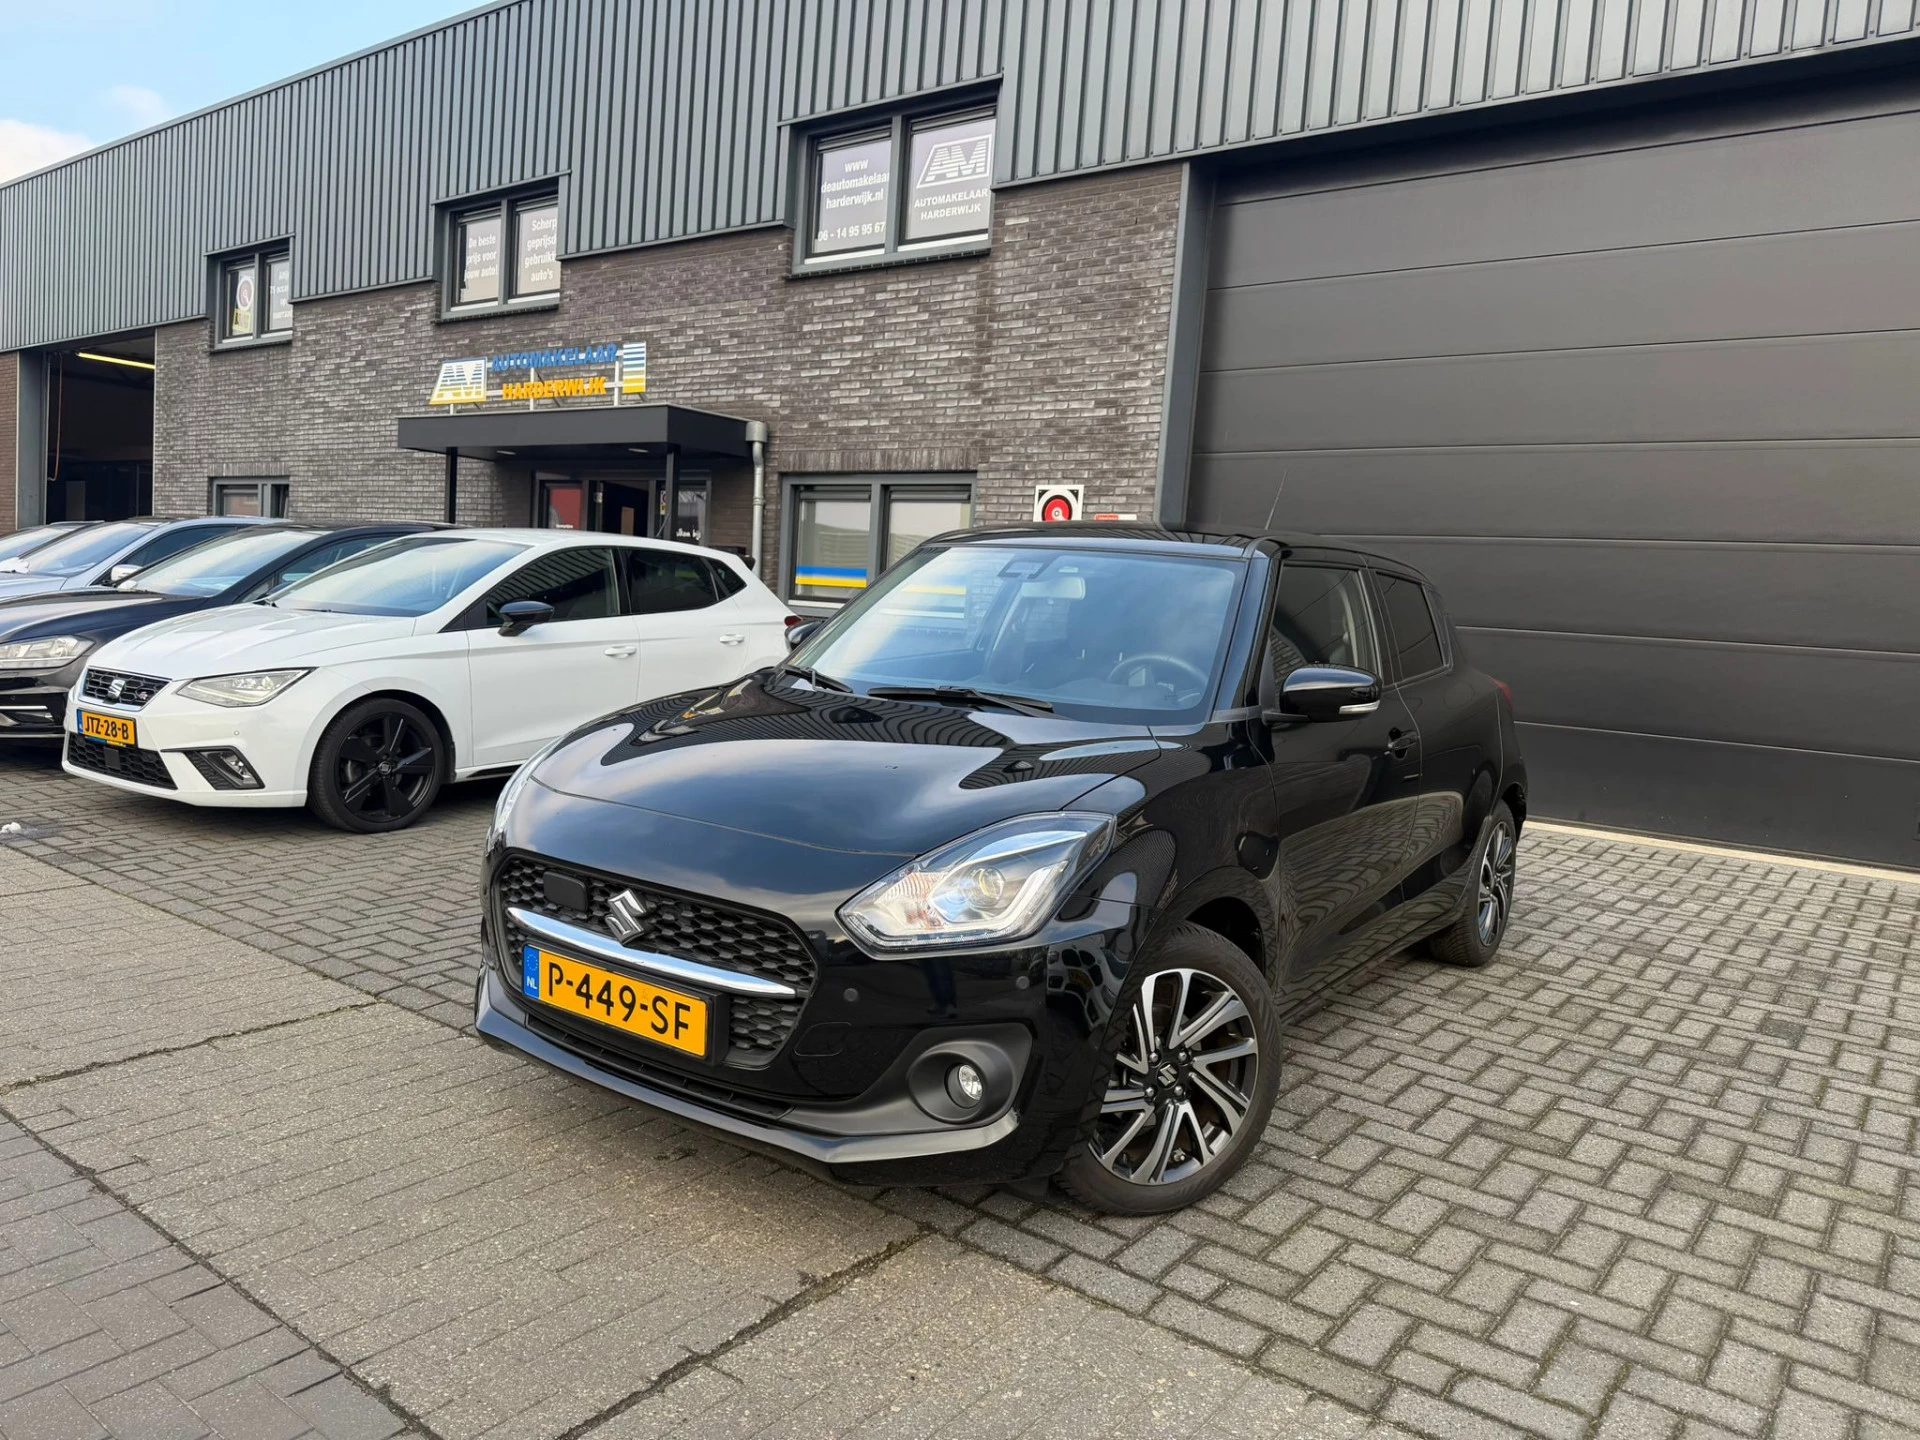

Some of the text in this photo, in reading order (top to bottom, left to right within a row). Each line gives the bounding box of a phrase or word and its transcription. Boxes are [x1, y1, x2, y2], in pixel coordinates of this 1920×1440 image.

[845, 160, 868, 172] www
[826, 188, 883, 209] harderwijk.nl
[914, 188, 988, 208] AUTOMAKELAAR
[921, 203, 981, 220] HARDERWIJK
[818, 230, 828, 241] 06
[837, 227, 846, 238] 14
[849, 225, 859, 237] 95
[862, 223, 872, 235] 95
[875, 221, 885, 233] 67
[530, 268, 554, 282] auto's
[492, 343, 619, 372] AUTOMAKELAAR
[502, 377, 607, 400] HARDERWIJK
[85, 715, 129, 741] JTZ-28-B
[526, 976, 537, 990] NL
[548, 962, 691, 1040] P-449-SF
